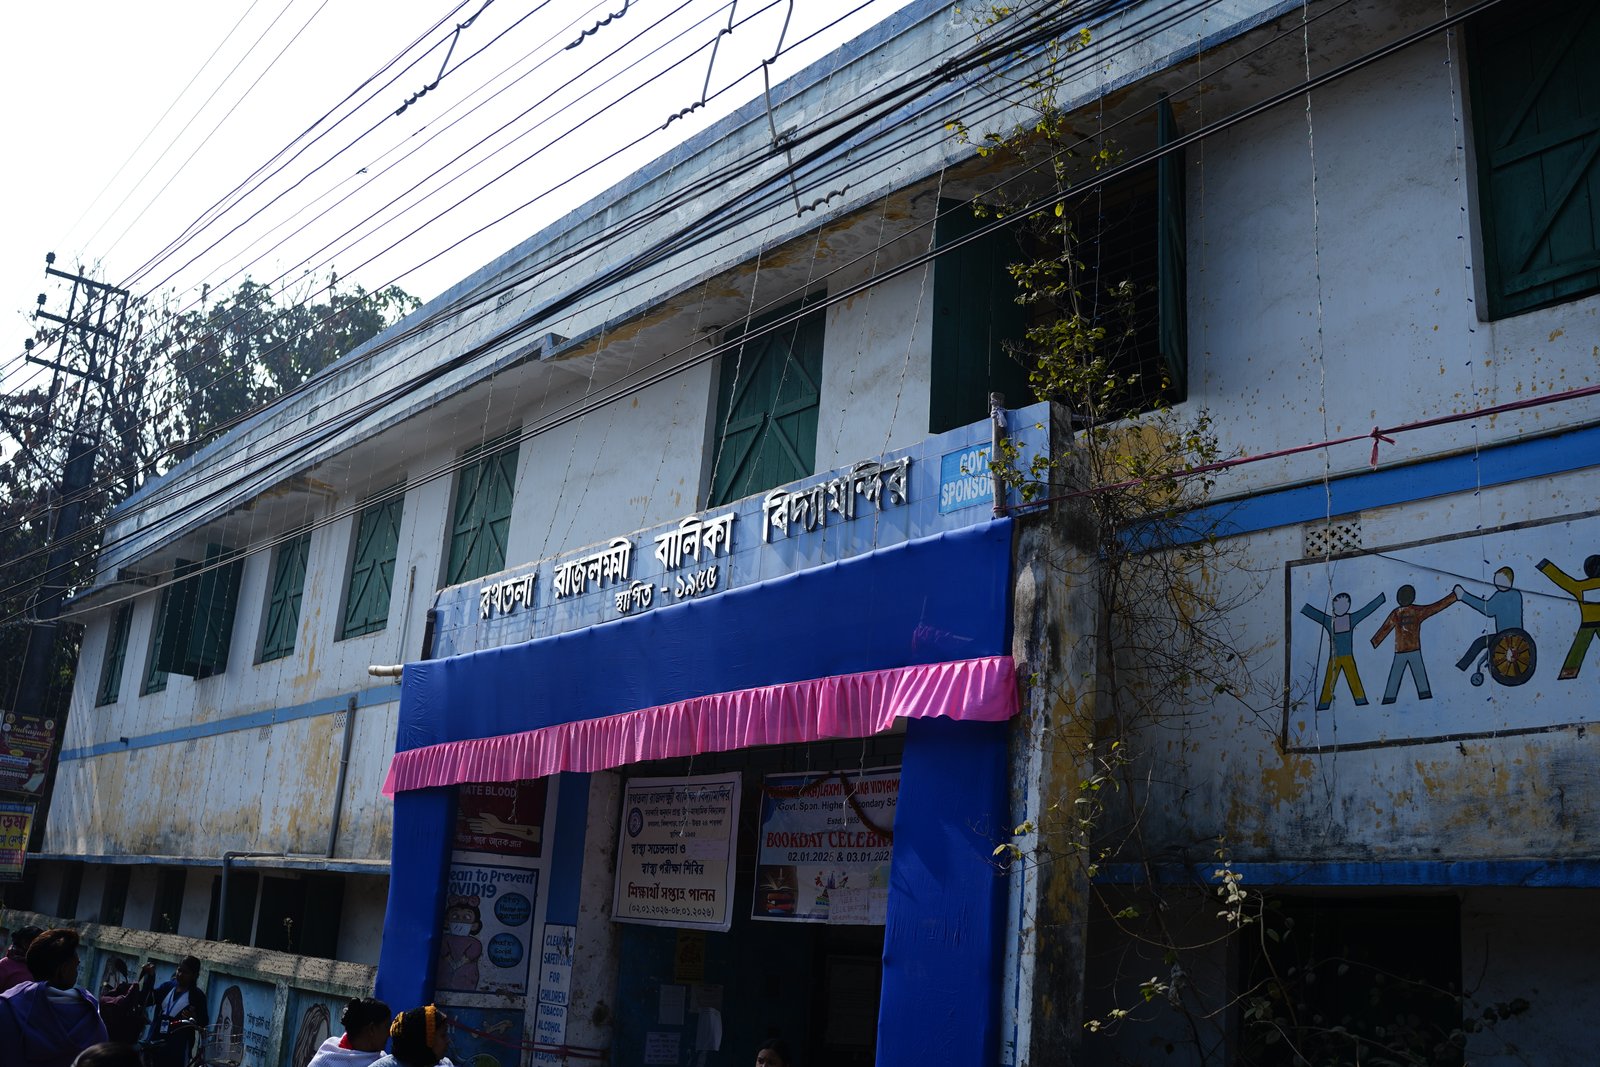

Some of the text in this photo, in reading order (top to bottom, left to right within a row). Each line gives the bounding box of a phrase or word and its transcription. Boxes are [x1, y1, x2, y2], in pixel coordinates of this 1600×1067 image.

[480, 572, 535, 620] রথতলা
[655, 512, 736, 571] বালিকা
[762, 456, 911, 544] বিদ্যামন্দির
[615, 580, 656, 613] স্থাপিত
[674, 565, 718, 599] ১৯৫৫
[485, 786, 516, 798] BLOOD
[821, 800, 844, 812] Highe
[766, 832, 823, 848] BOOKDAY
[648, 843, 678, 854] সচেতনতা
[679, 844, 686, 853] ও
[836, 851, 844, 862] &
[659, 859, 682, 874] পরীক্ষা
[683, 860, 704, 874] শিবির
[475, 869, 488, 882] to
[489, 869, 536, 884] Prevent
[661, 887, 687, 902] সপ্তাহ
[688, 888, 716, 902] পালন
[549, 971, 561, 984] FOR
[540, 988, 567, 1004] CHILDREN
[540, 1004, 564, 1018] TOBACCO
[538, 1019, 561, 1033] ALCOHOL
